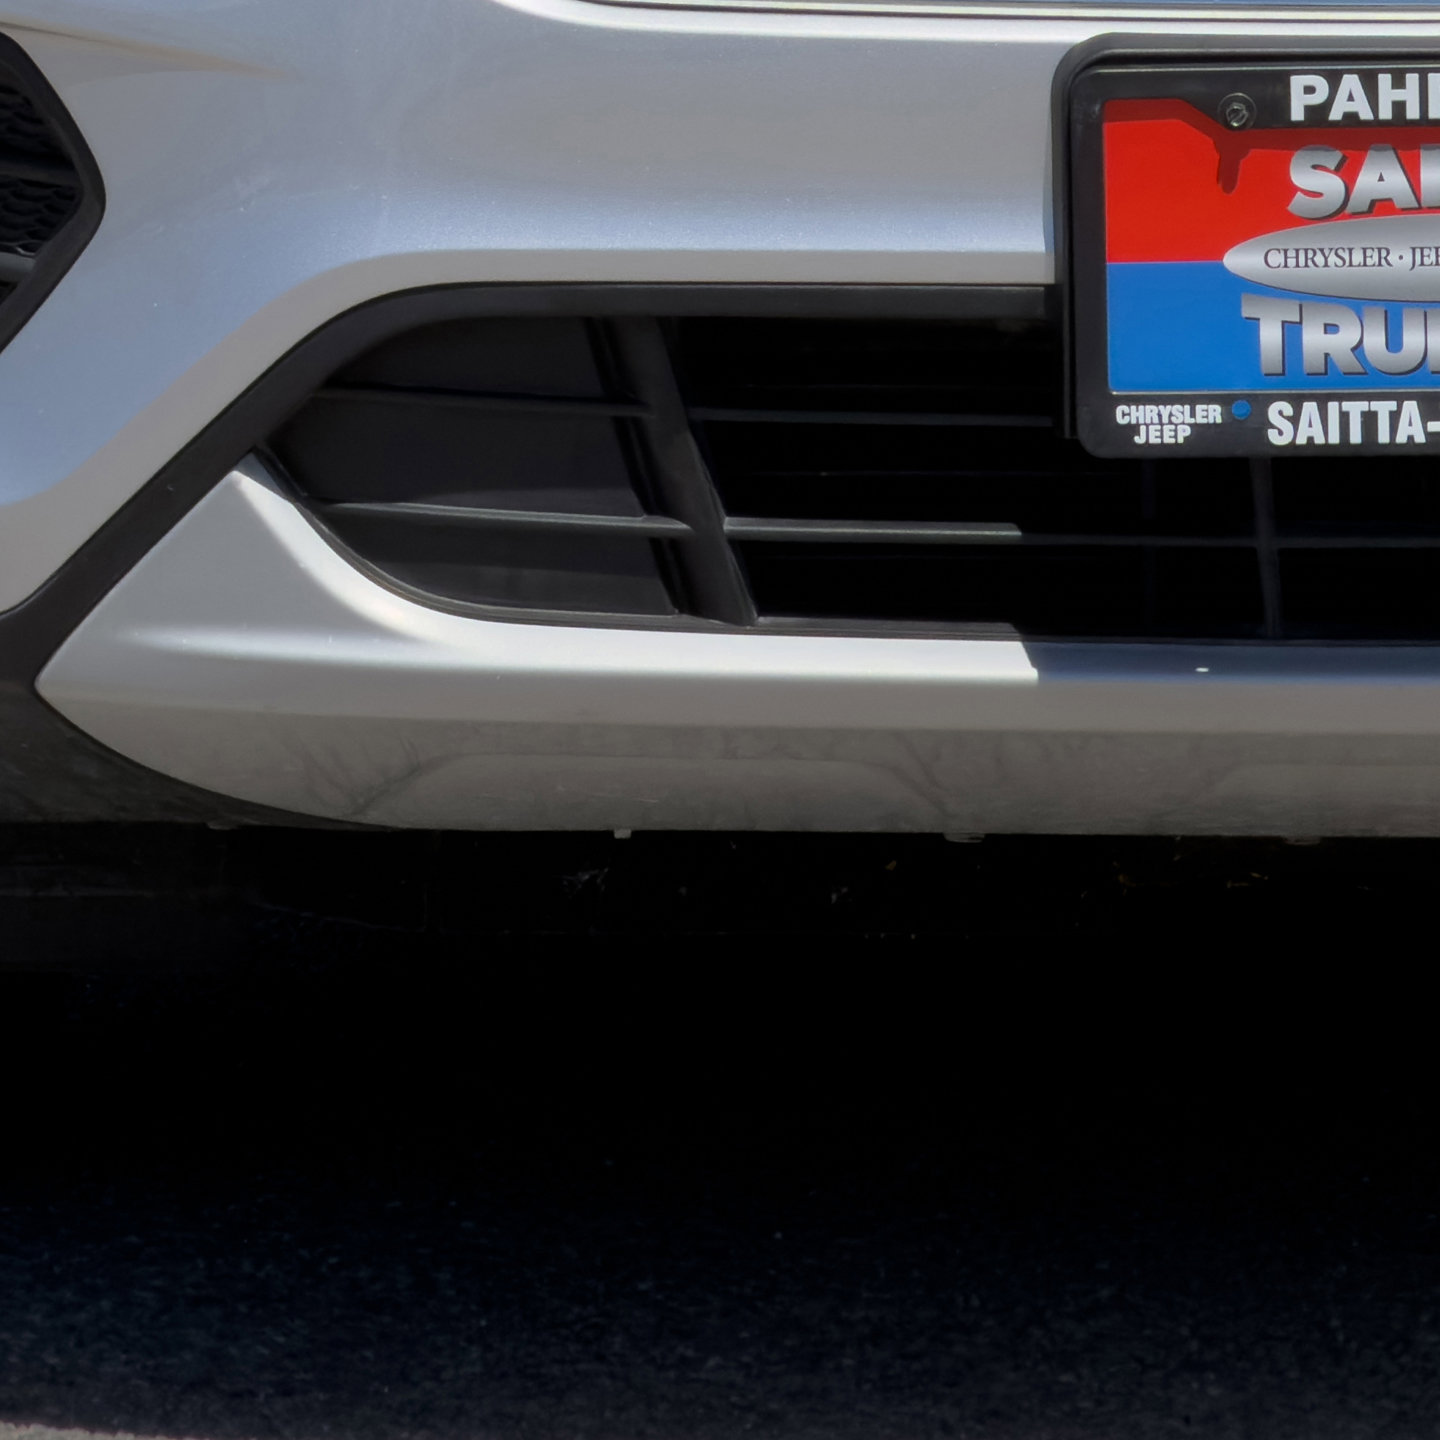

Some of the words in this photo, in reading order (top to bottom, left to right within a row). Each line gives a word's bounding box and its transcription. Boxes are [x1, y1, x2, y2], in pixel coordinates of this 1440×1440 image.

[1263, 246, 1394, 270] CHRYSLER
[1116, 404, 1222, 424] CHRYSLER
[1133, 424, 1191, 444] JEEP
